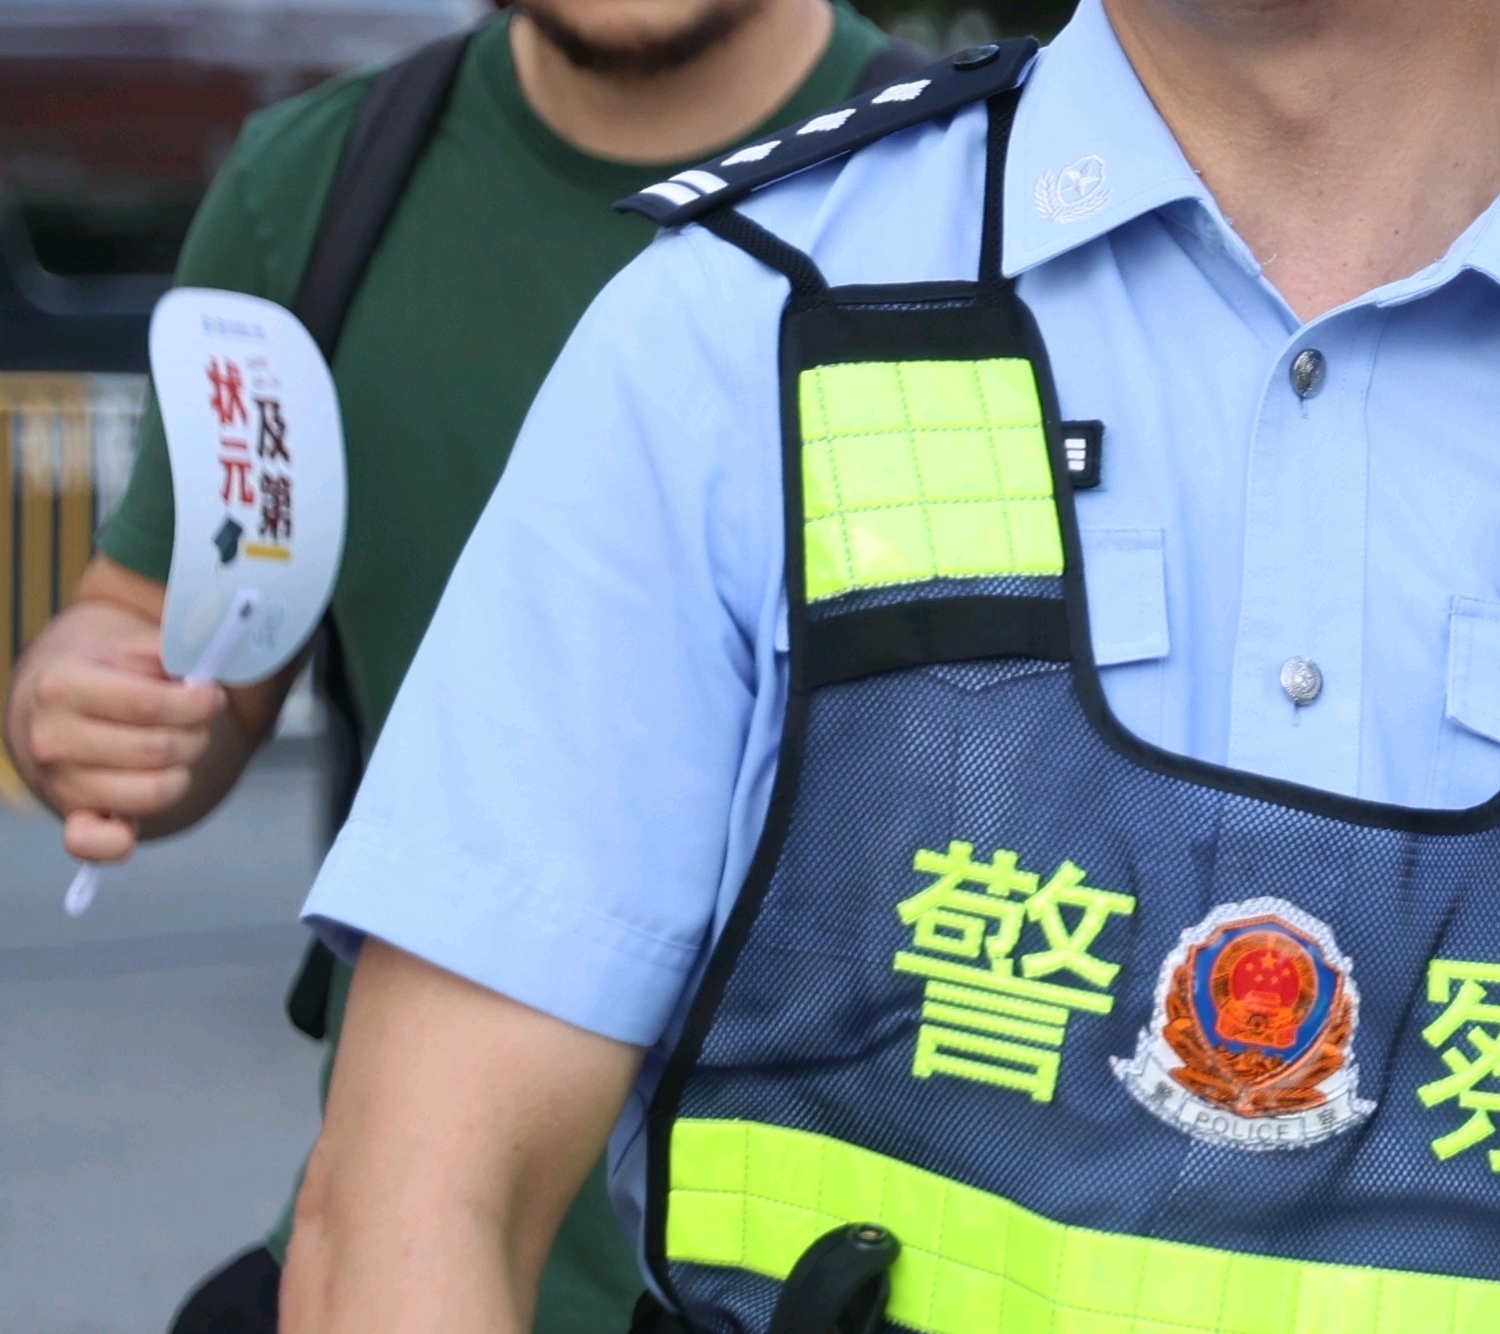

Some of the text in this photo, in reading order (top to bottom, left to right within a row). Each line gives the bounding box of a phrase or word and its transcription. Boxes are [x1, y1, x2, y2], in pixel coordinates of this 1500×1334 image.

[204, 354, 256, 508] 状元
[252, 395, 293, 542] 及第
[894, 841, 1138, 1104] 警
[1195, 1111, 1291, 1140] POLICE
